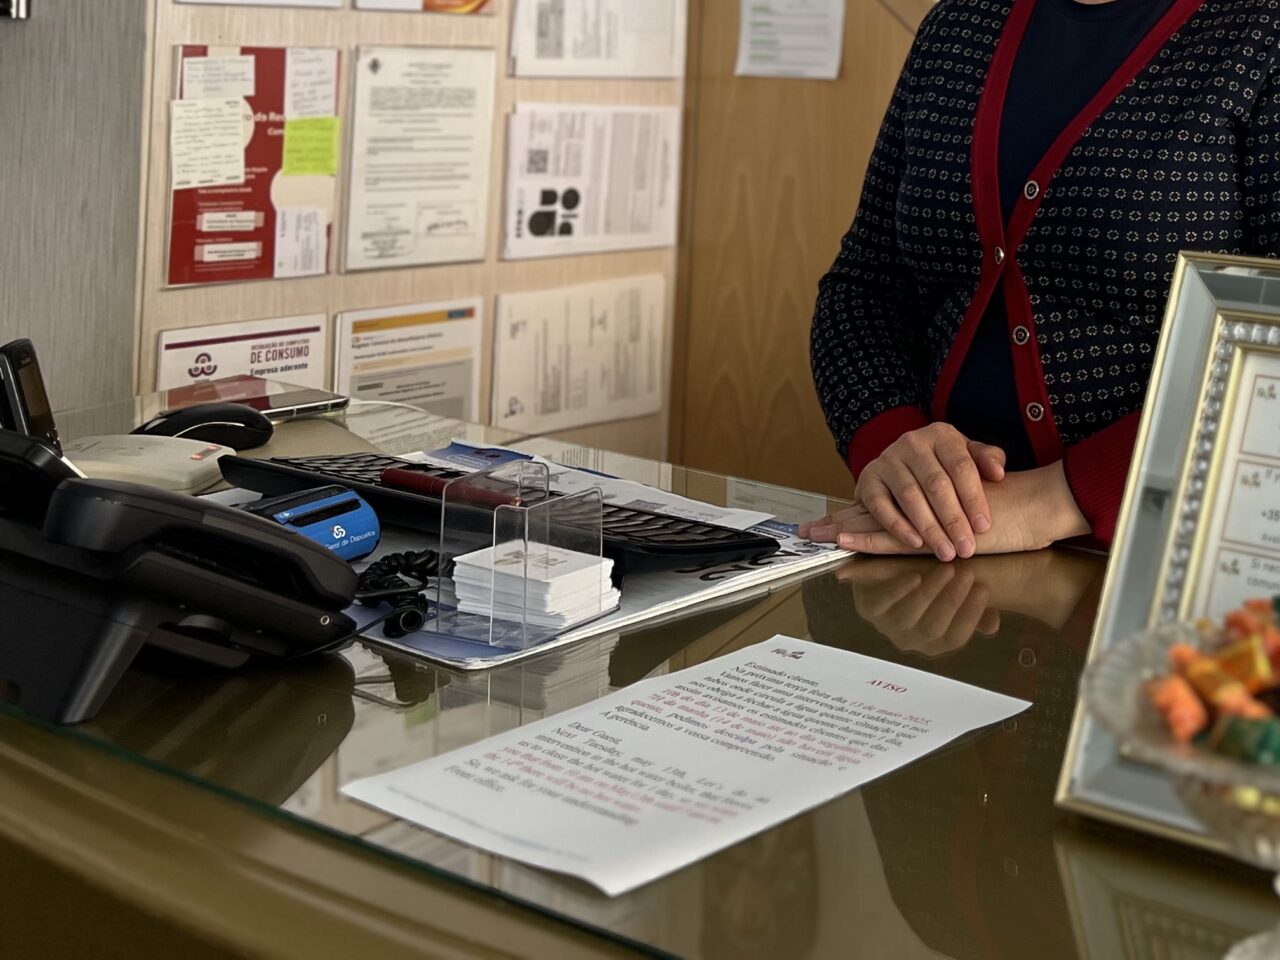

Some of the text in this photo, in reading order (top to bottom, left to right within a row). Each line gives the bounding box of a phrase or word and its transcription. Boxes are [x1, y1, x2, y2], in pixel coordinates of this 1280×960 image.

[250, 345, 309, 364] DE CONSUMO
[251, 362, 308, 377] Empresa aderente
[1265, 469, 1272, 479] If
[1251, 559, 1260, 570] Si
[744, 662, 787, 676] Estimado
[743, 672, 784, 684] próxima
[808, 690, 831, 698] feira
[866, 679, 909, 694] AVISO
[720, 671, 749, 683] Vamos
[748, 681, 774, 690] fazer
[793, 695, 848, 712] intervenção
[862, 714, 902, 726] caldeira
[753, 692, 786, 704] circula
[818, 712, 853, 723] quente
[615, 706, 674, 728] agradecemos
[684, 728, 711, 740] vossa
[674, 685, 702, 695] assim
[702, 694, 745, 710] avisamos
[760, 713, 808, 729] estimados
[808, 728, 848, 741] clientes
[706, 687, 737, 697] obriga
[743, 698, 774, 709] fechar
[804, 717, 838, 728] quente
[838, 726, 877, 739] durante
[740, 716, 766, 726] maio
[666, 713, 710, 729] pedimos
[714, 728, 758, 744] desculpa
[759, 744, 785, 753] pela
